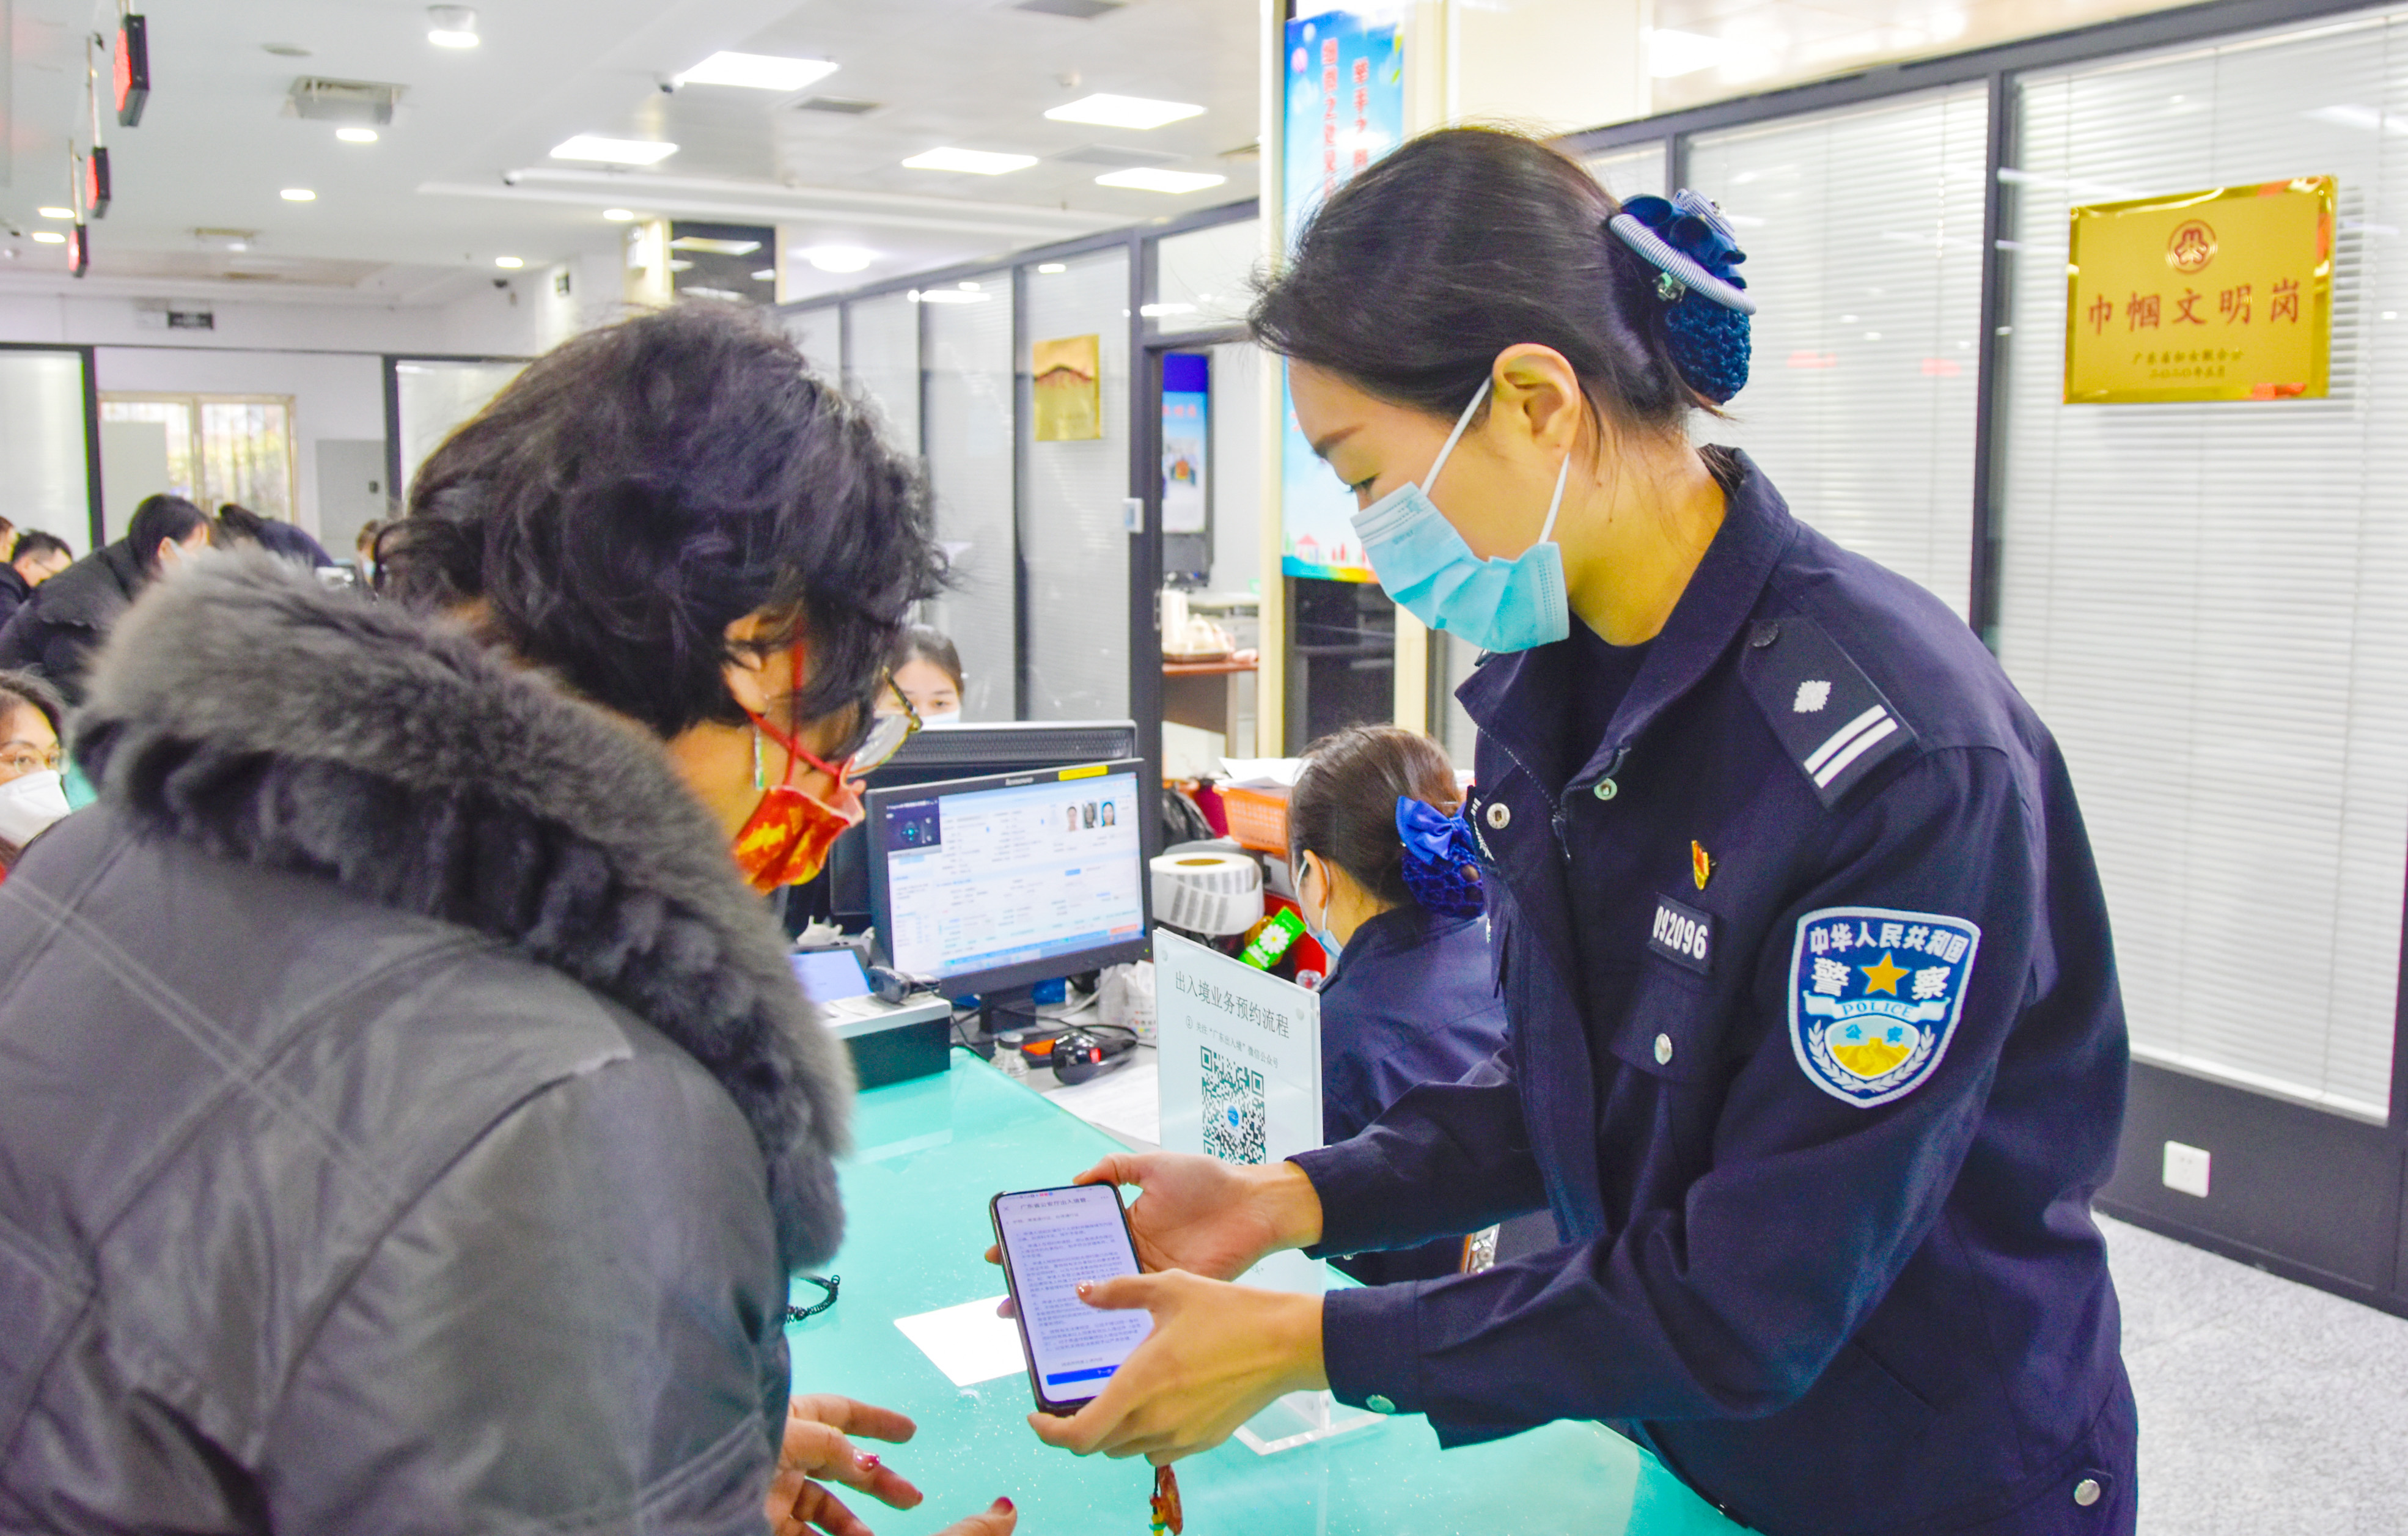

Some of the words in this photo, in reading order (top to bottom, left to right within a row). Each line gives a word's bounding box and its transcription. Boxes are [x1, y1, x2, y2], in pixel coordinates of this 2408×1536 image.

[2088, 277, 2300, 336] 巾帼文明岗
[1653, 906, 1708, 960] 092096
[1809, 922, 1969, 964] 中华人民共和国
[1175, 970, 1290, 1039] 出入境业务预约流程
[1841, 1001, 1914, 1018] POLICE
